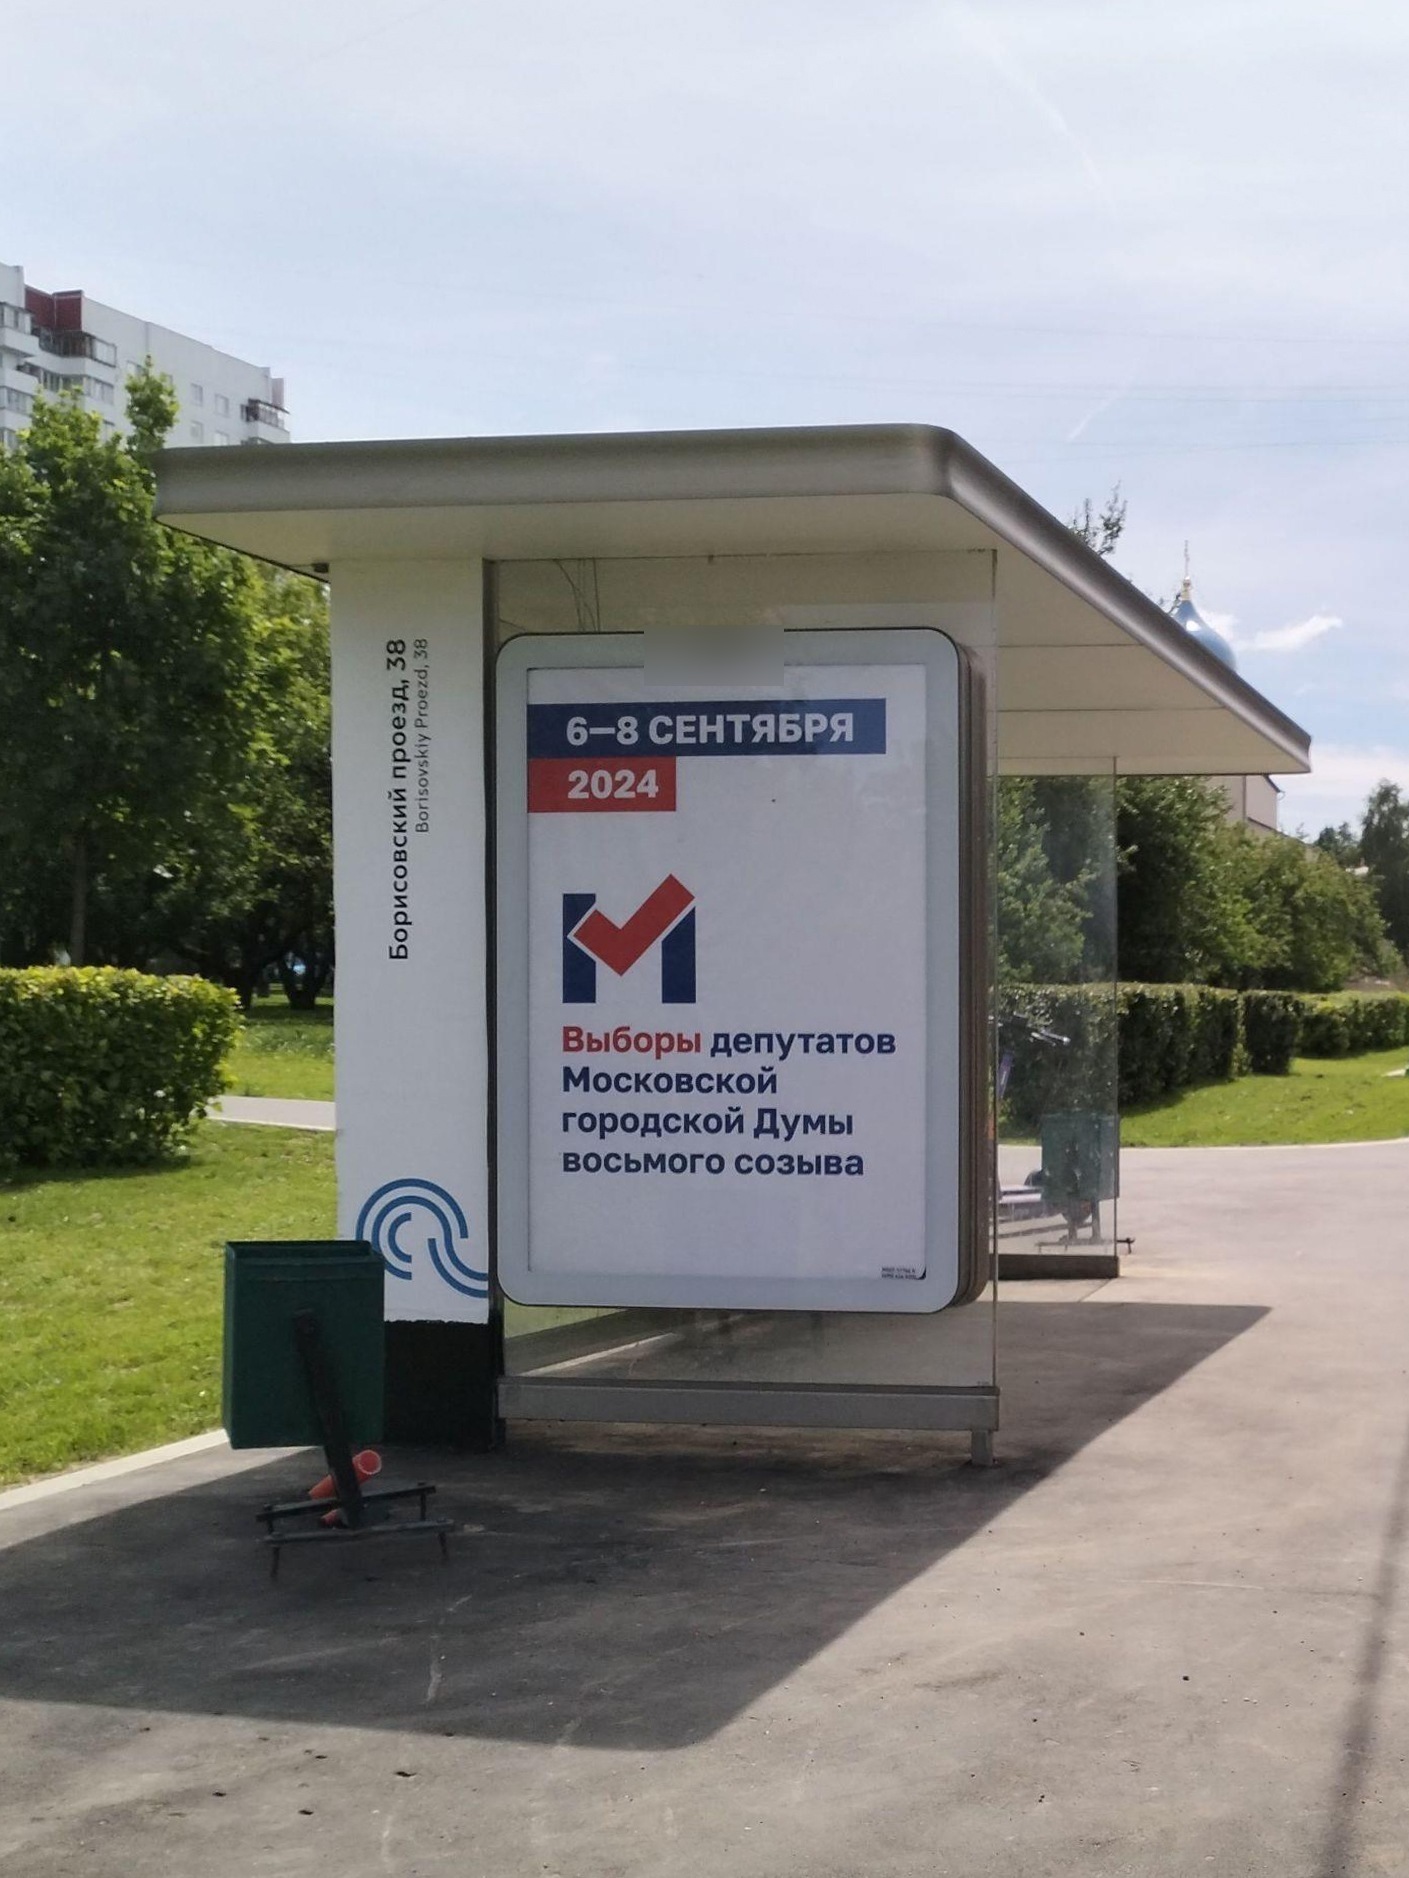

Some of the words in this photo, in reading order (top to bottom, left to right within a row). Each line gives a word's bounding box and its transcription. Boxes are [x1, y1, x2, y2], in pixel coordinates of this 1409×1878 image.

[386, 639, 406, 671] 38
[413, 638, 428, 659] 38
[413, 664, 430, 728] Proezd,
[392, 679, 411, 779] проезд,
[649, 712, 854, 745] СЕНТЯБРЯ
[414, 733, 431, 833] Borisovskiy
[567, 769, 659, 799] 2024
[387, 787, 413, 960] Борисовский
[562, 1026, 701, 1060] Выборы
[710, 1032, 896, 1061] депутатов
[562, 1066, 777, 1094] Московской
[562, 1106, 744, 1140] городской
[753, 1107, 853, 1141] Думы
[562, 1152, 726, 1174] восьмого
[734, 1153, 864, 1176] созыва
